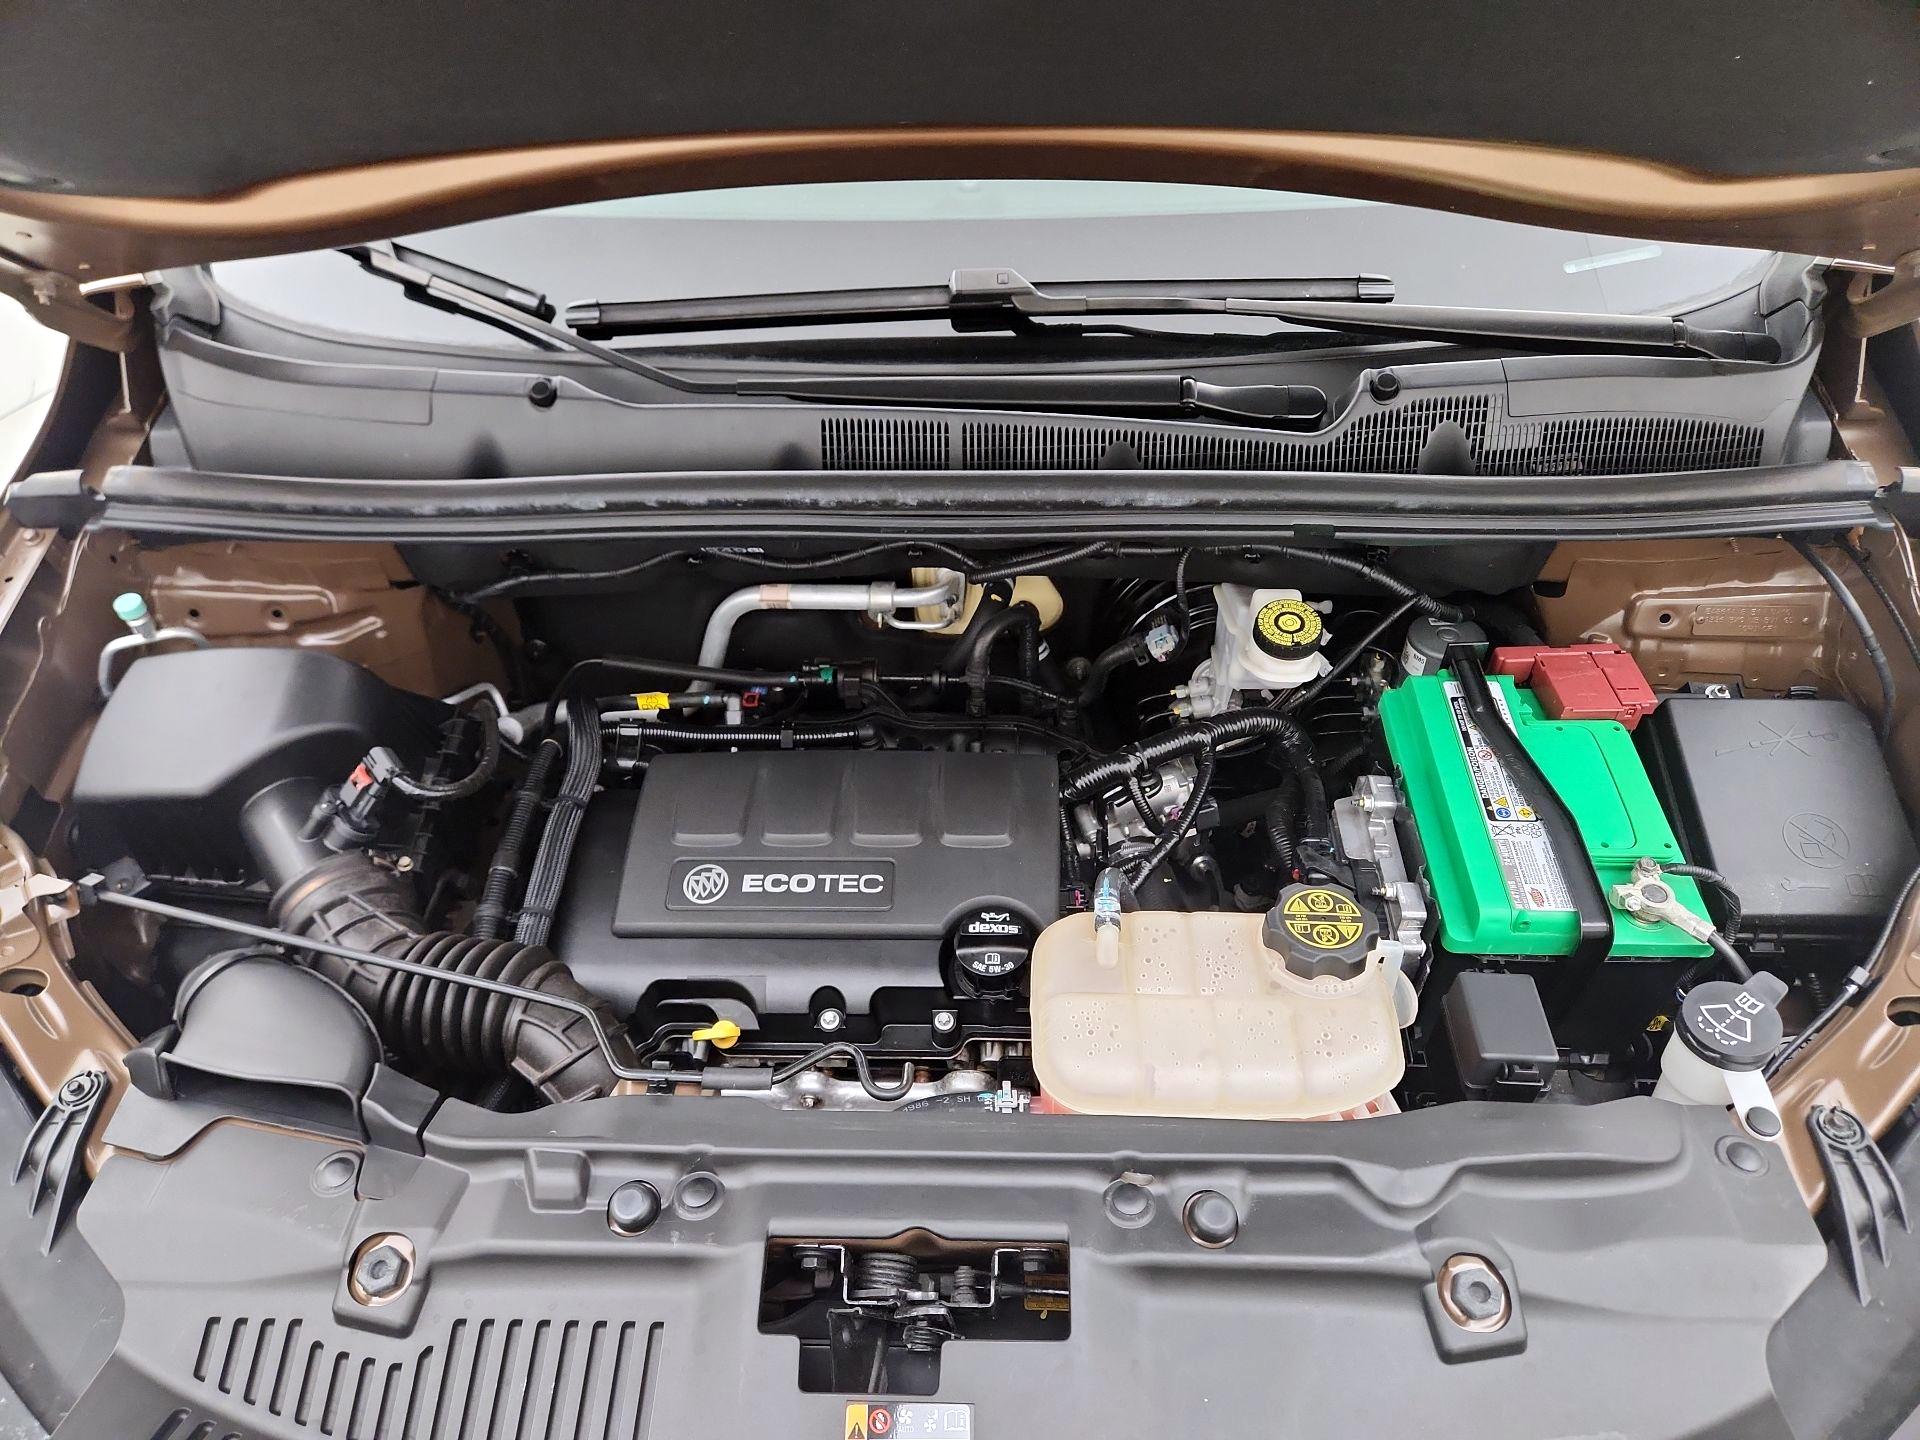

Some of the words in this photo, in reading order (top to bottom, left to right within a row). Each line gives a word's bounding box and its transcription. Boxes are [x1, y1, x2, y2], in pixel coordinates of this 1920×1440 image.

[1466, 746, 1489, 799] DANGER/POISON
[741, 873, 884, 894] ECOTEC
[968, 921, 1019, 934] dexos
[972, 961, 987, 972] SAE
[988, 961, 1014, 973] 5W-30
